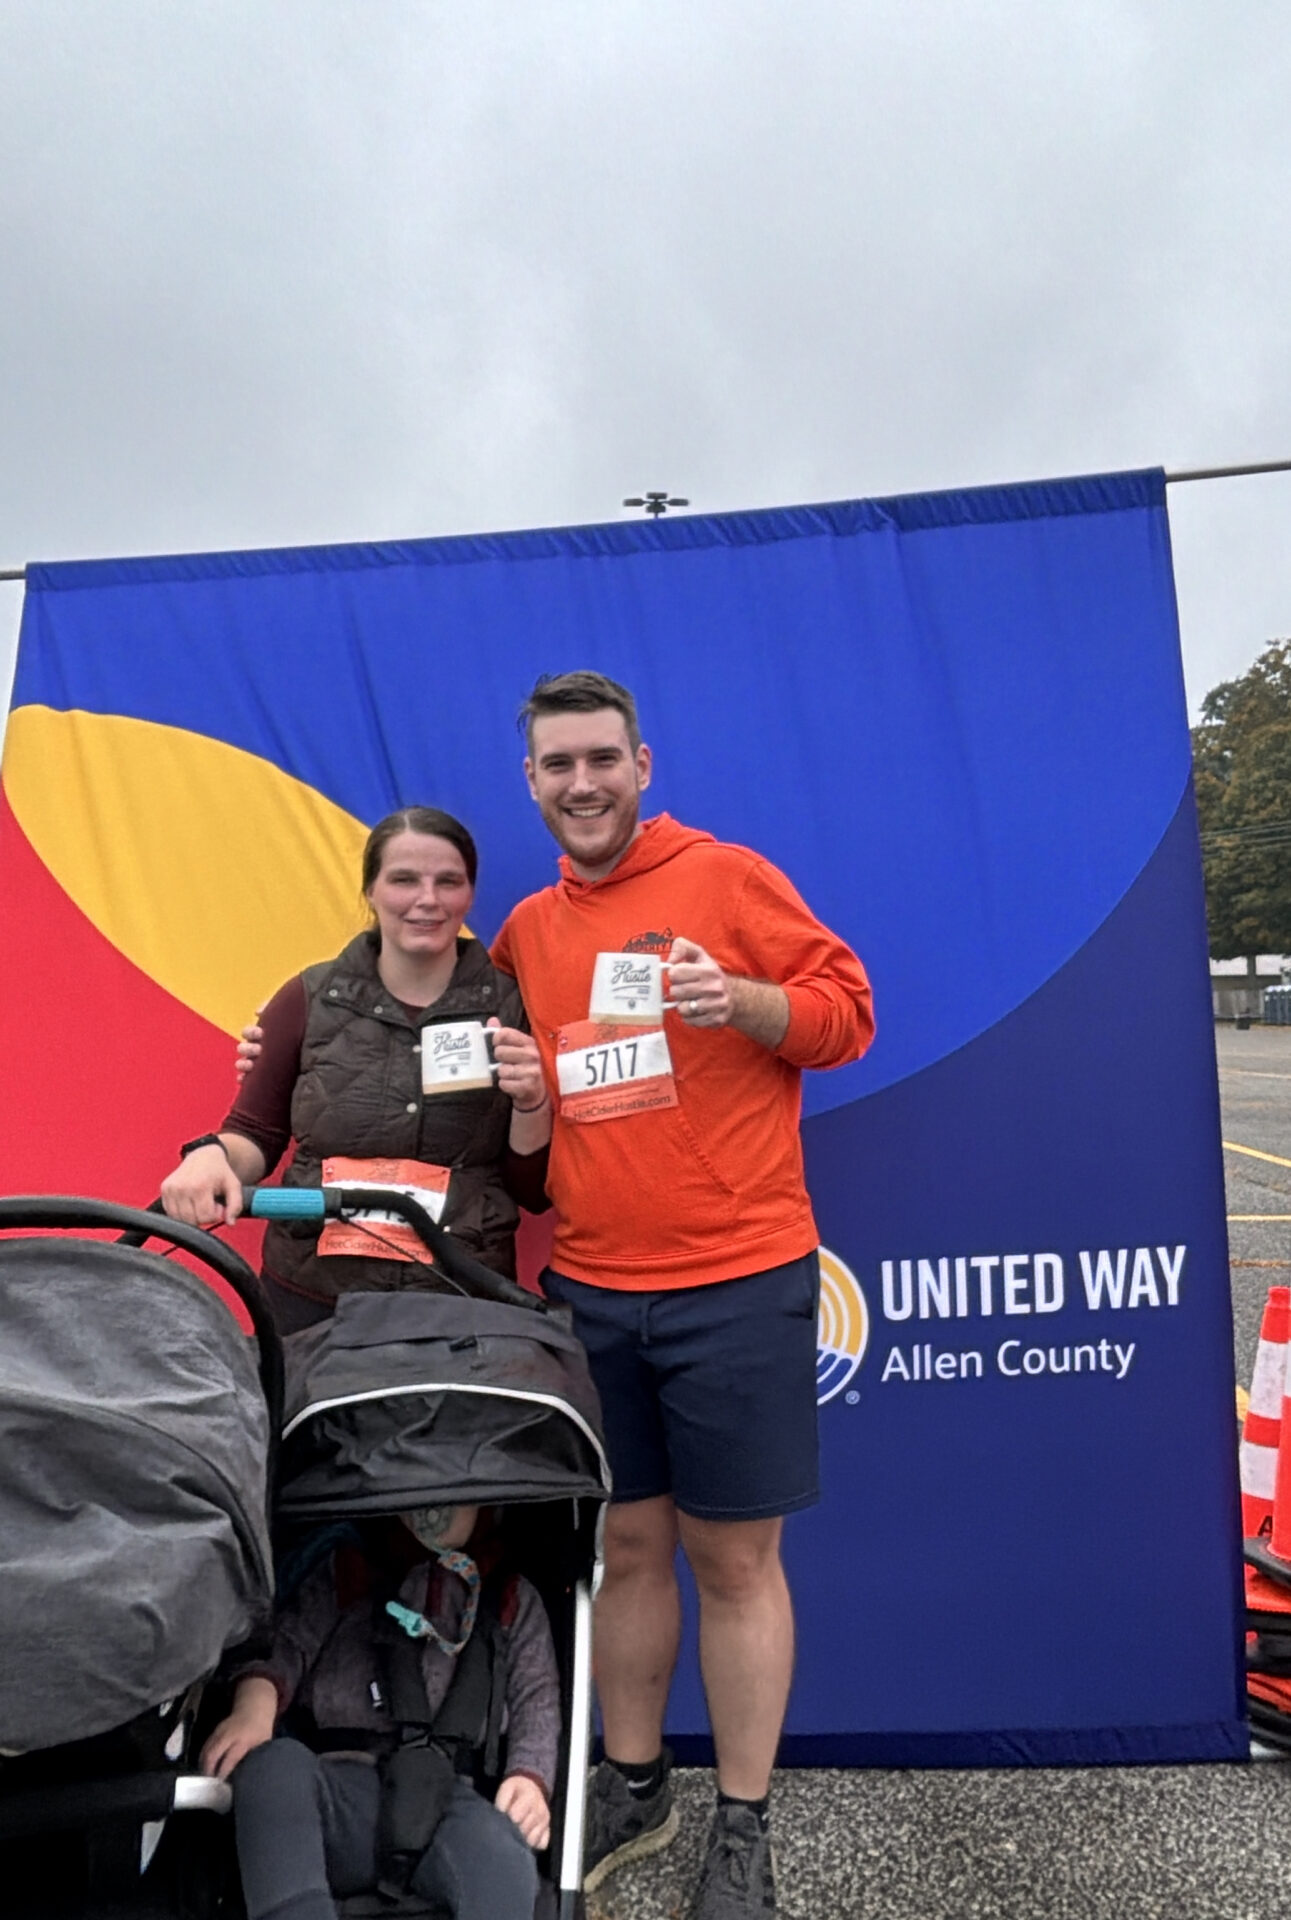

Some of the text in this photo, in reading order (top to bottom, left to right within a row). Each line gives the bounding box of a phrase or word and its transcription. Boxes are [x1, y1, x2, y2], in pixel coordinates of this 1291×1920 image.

[585, 1042, 638, 1087] 5717
[881, 1245, 1187, 1321] UNITED WAY
[881, 1338, 1136, 1382] Allen County
